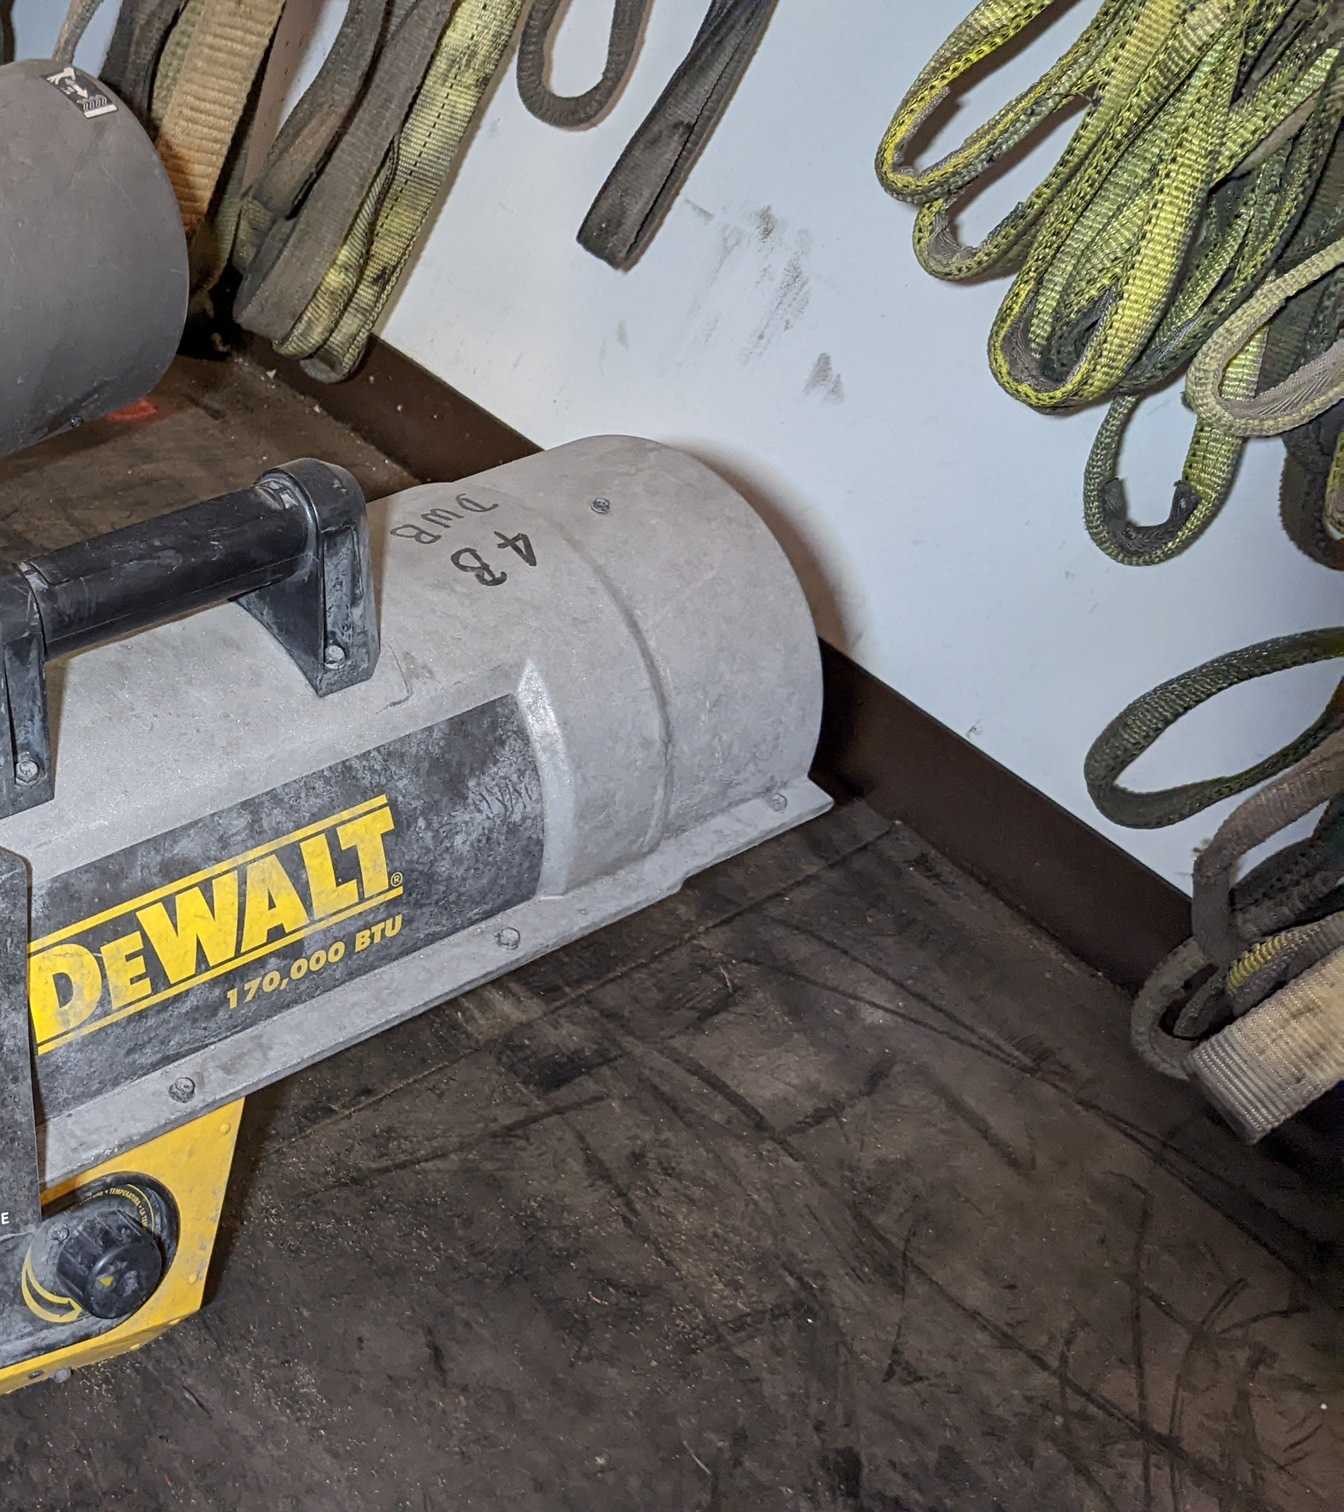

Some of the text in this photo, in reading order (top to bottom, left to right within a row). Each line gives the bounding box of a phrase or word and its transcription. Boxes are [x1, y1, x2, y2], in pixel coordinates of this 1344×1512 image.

[30, 805, 396, 1044] DEWALT
[225, 914, 404, 1009] 170,000 BTU
